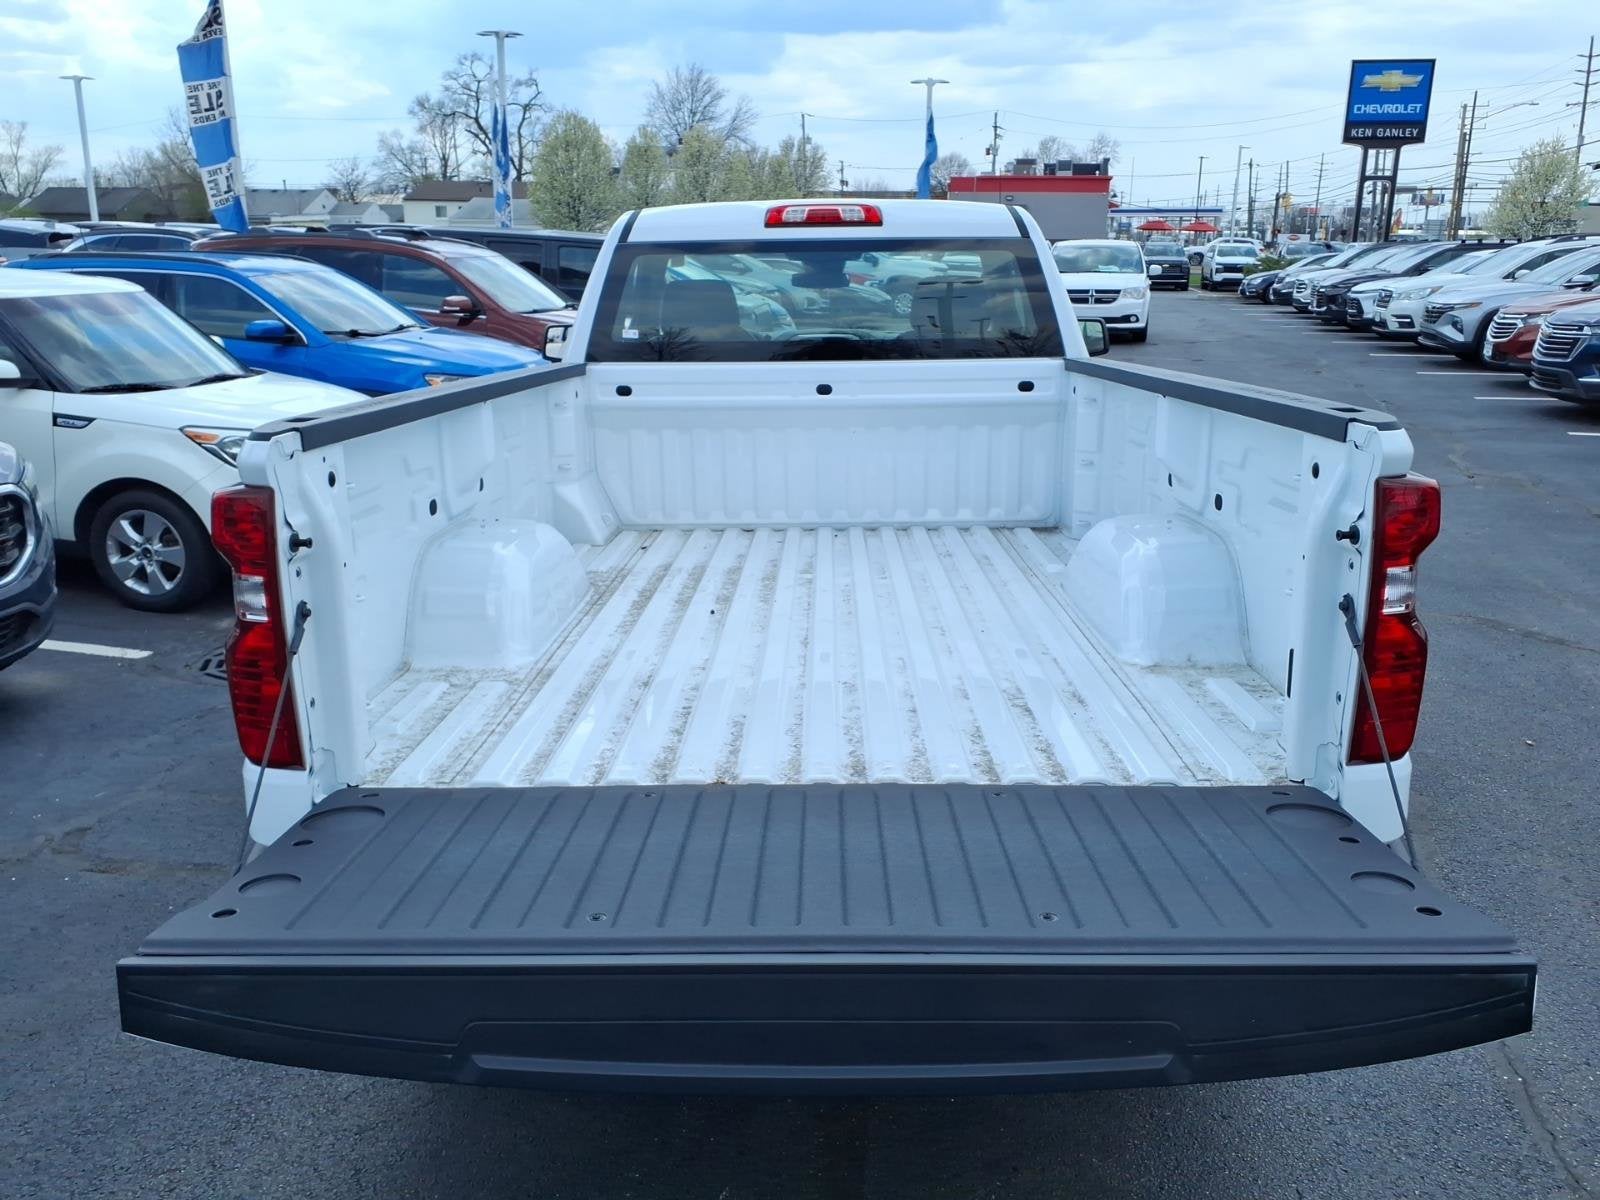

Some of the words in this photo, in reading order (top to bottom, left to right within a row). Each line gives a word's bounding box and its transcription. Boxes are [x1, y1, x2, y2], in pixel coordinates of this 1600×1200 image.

[1353, 103, 1422, 114] CHEVROLET
[1351, 128, 1372, 137] KEN
[1376, 128, 1419, 137] GANLEY
